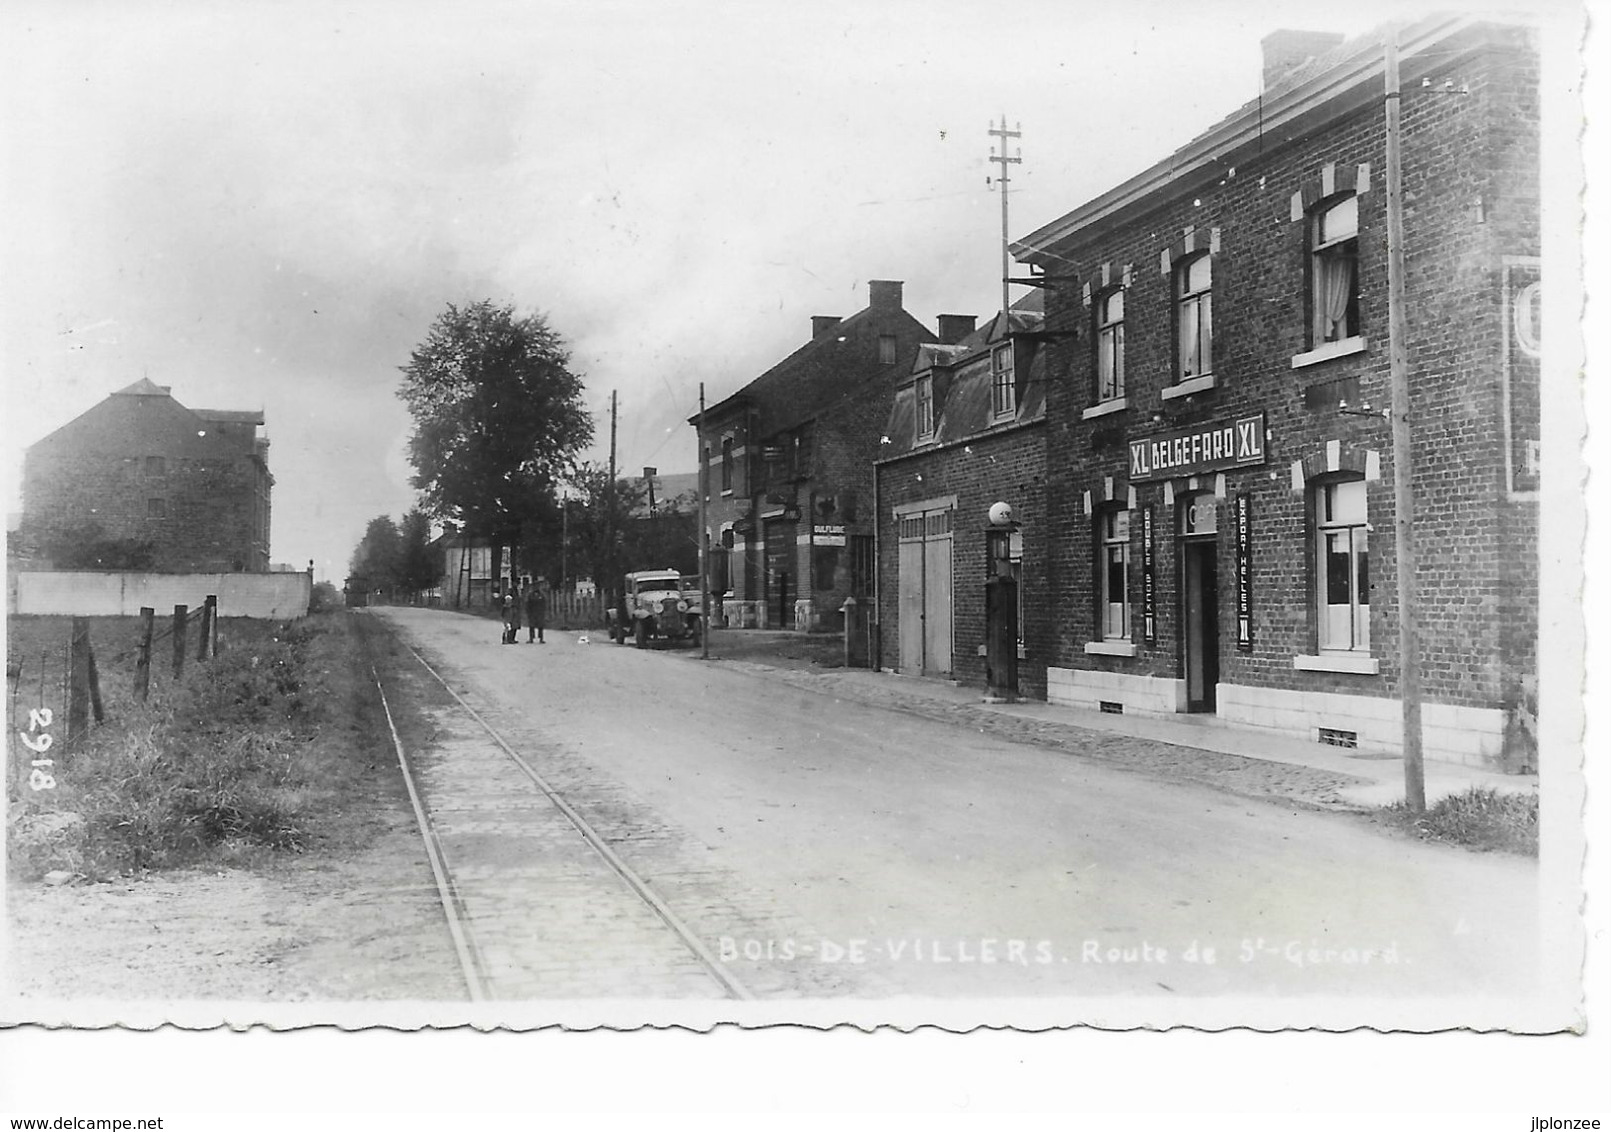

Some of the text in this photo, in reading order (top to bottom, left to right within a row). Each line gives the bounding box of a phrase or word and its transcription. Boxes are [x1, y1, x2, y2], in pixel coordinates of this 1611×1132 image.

[1131, 422, 1261, 475] XL BELGEFARO XL
[1239, 498, 1247, 551] EXPORT
